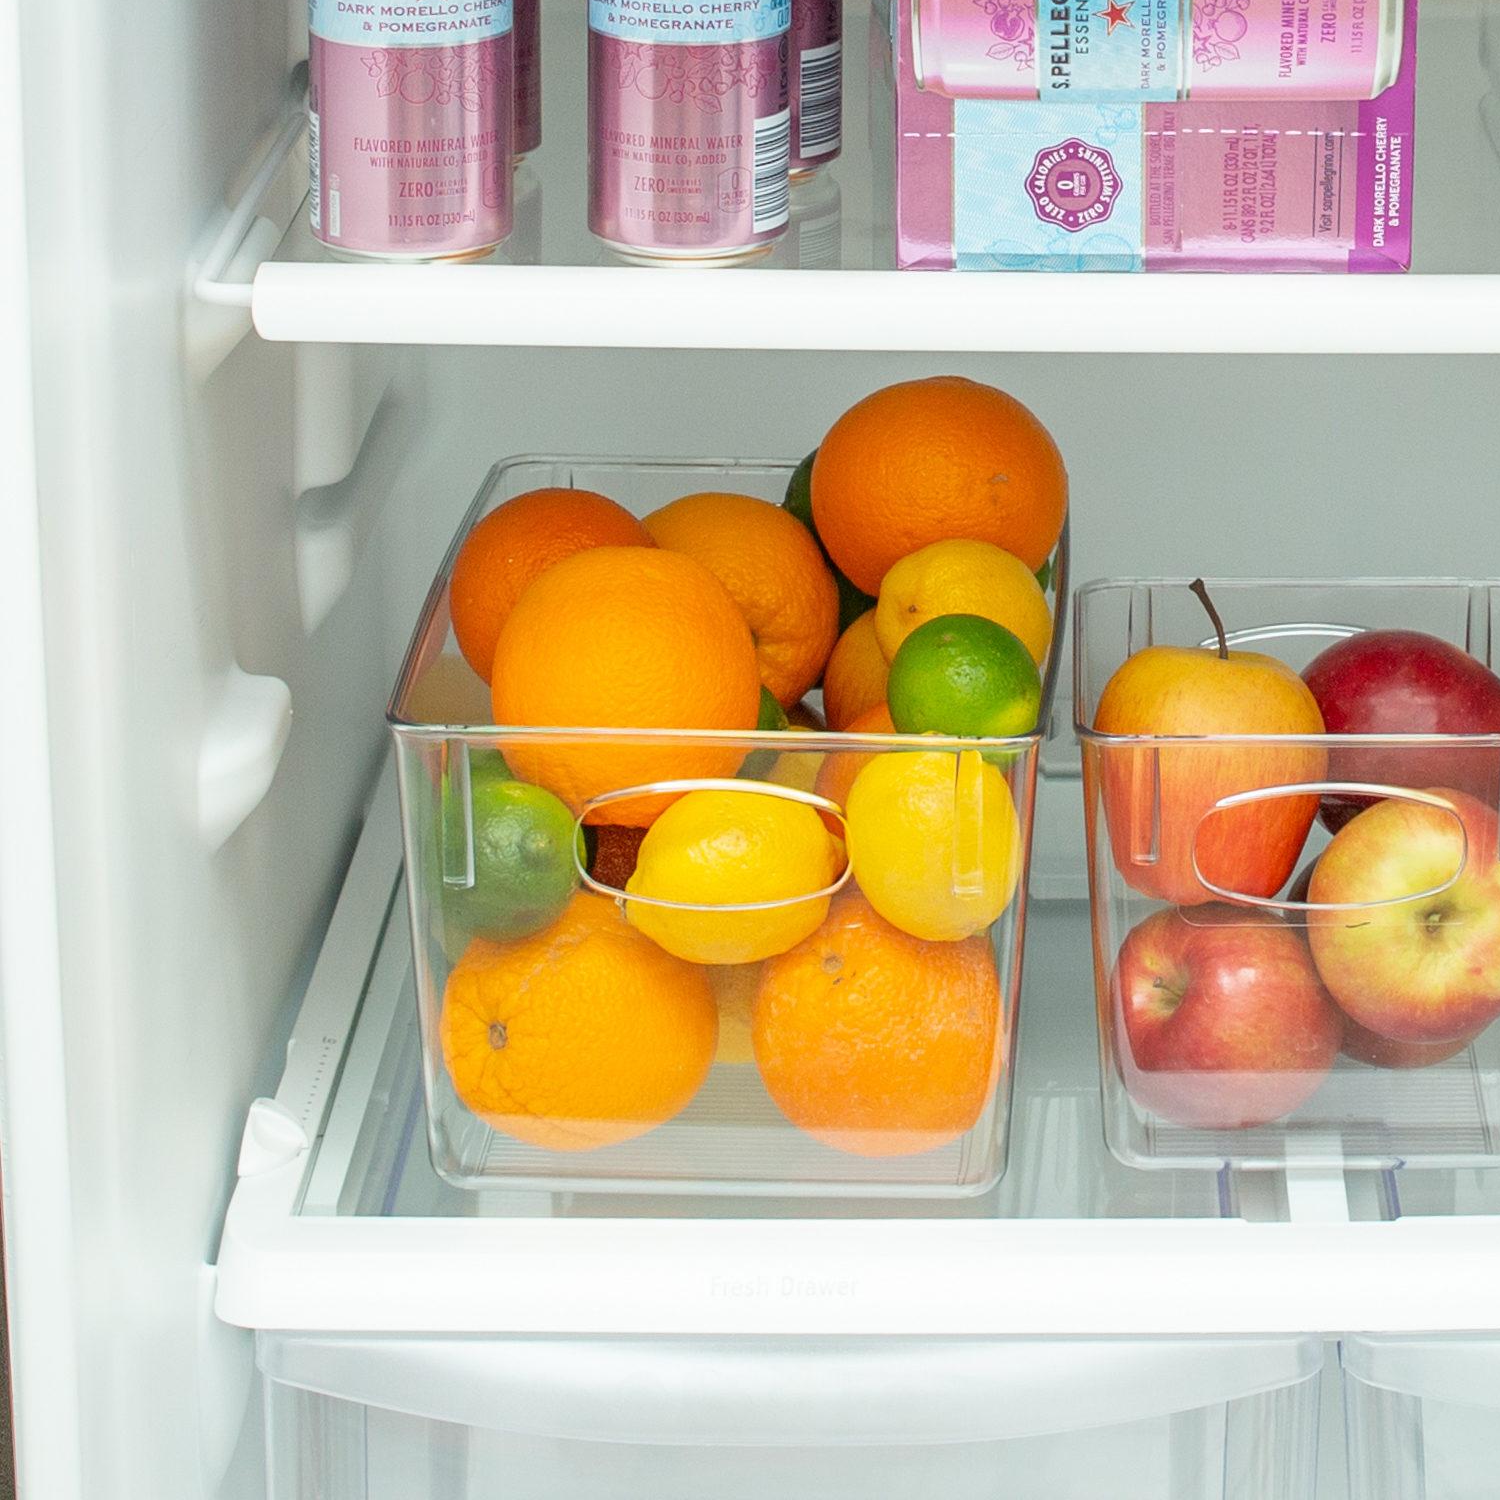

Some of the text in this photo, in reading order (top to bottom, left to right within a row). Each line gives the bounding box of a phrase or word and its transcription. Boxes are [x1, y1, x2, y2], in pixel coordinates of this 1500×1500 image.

[337, 1, 375, 16] DARK
[380, 4, 459, 17] MORELLO
[620, 0, 761, 15] MORELLO CHERRY
[1353, 6, 1365, 19] OZ
[378, 15, 492, 33] POMEGRANATE
[619, 15, 734, 30] POMEGRANATE
[1298, 6, 1309, 45] NATURAL
[1321, 12, 1337, 43] ZERO
[1279, 31, 1294, 78] FLAVORED
[1141, 62, 1150, 90] DARK
[354, 137, 467, 154] FLAVORED MINERAL
[651, 134, 743, 150] MINERAL WATER
[369, 155, 440, 169] WITH NATURAL
[632, 151, 727, 165] NATURAL ADDED
[399, 181, 434, 198] ZERO
[634, 176, 666, 193] ZERO
[1034, 148, 1067, 221] ZERO CALORIES
[1077, 147, 1114, 224] ZERO SWEETENERS
[1319, 132, 1337, 233] Visit sanpellegrino.com
[1373, 117, 1388, 248] DARK MORELLO CHERRY
[1388, 136, 1401, 227] & POMEGRANATE
[388, 213, 441, 228] 11.15 FL OZ
[658, 211, 671, 223] OZ
[709, 1274, 858, 1298] Fresh Drawer
